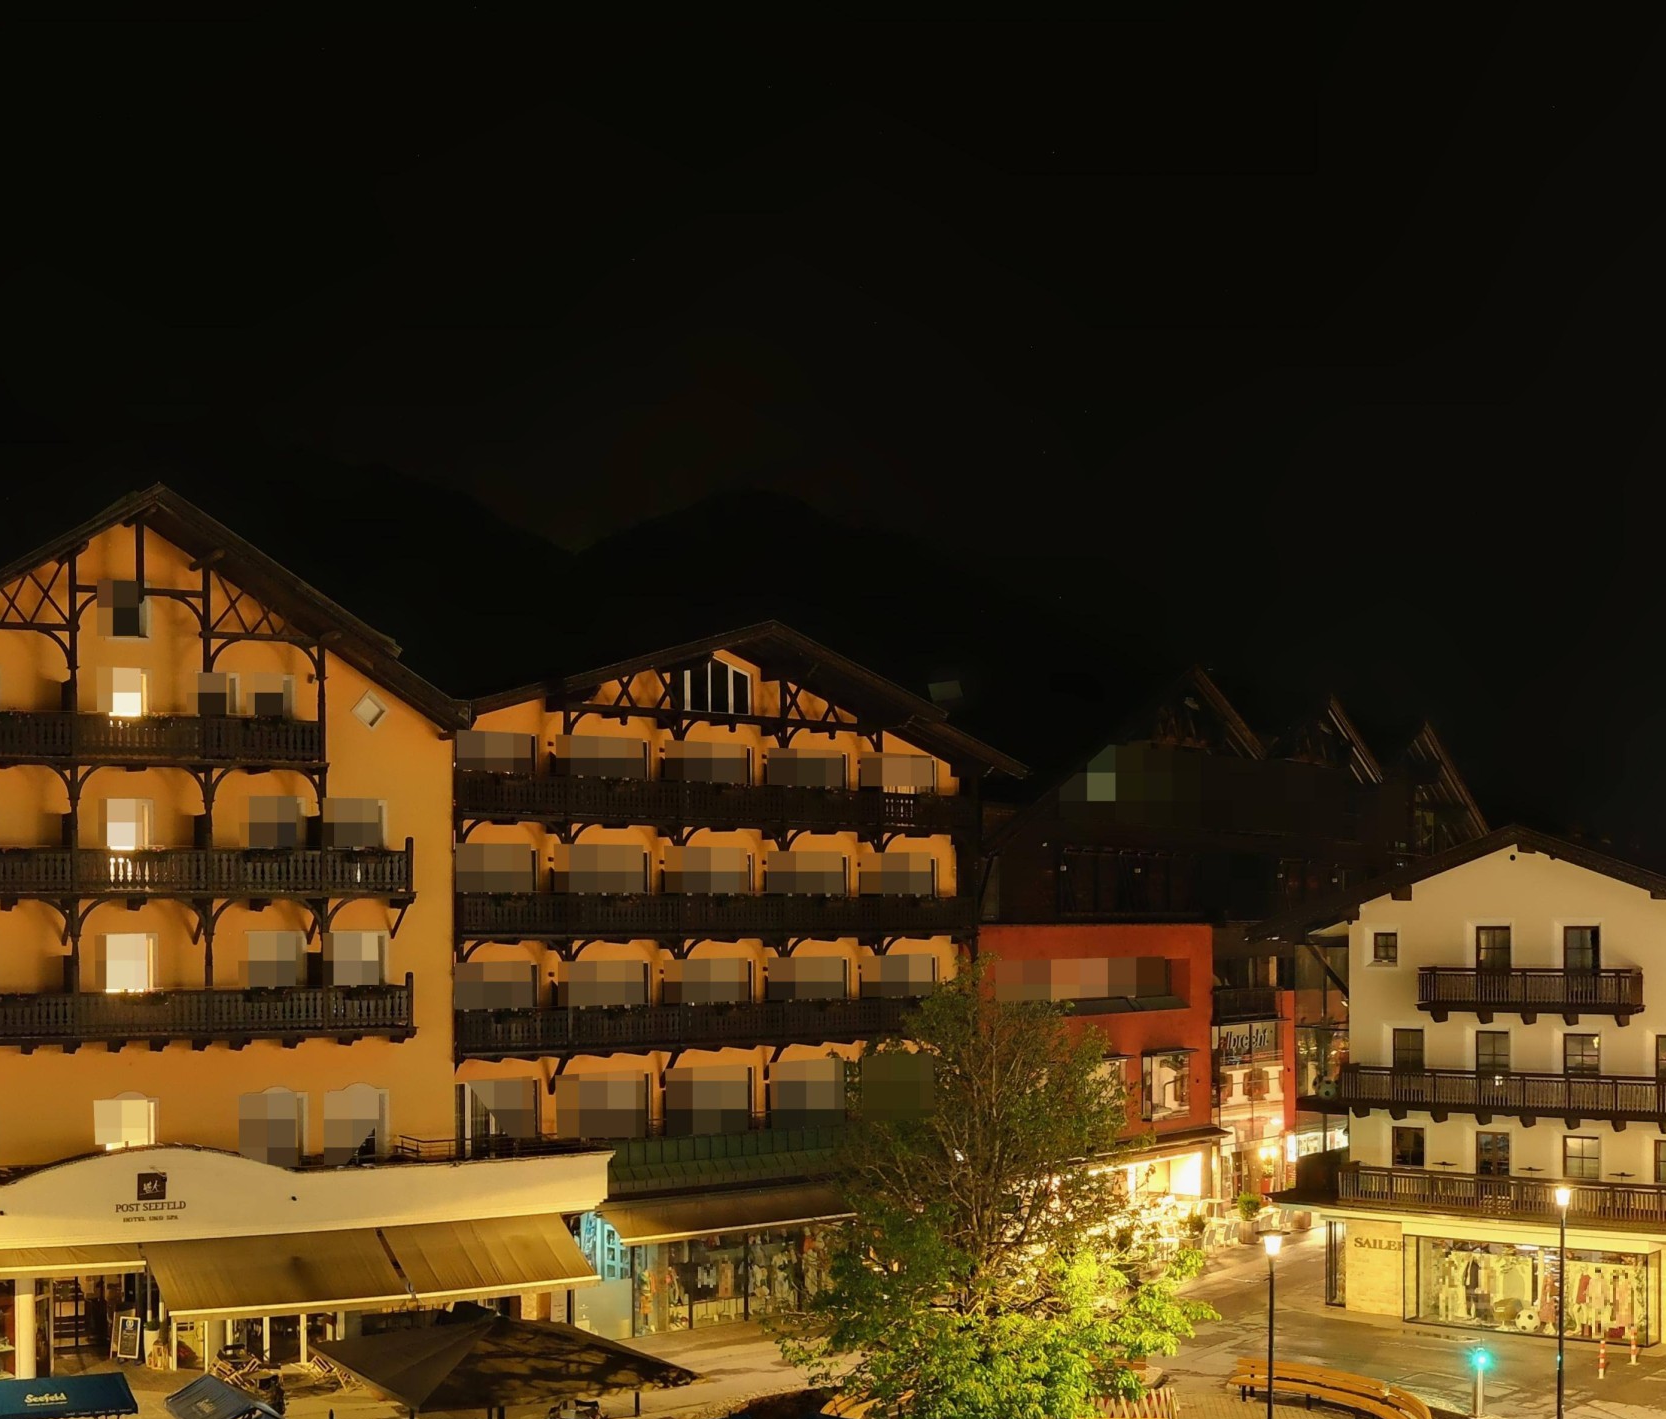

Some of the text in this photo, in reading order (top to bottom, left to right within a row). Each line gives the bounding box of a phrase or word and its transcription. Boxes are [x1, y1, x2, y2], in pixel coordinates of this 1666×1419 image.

[115, 1200, 187, 1213] POST SEEFELD
[24, 1392, 68, 1404] Seefeld
